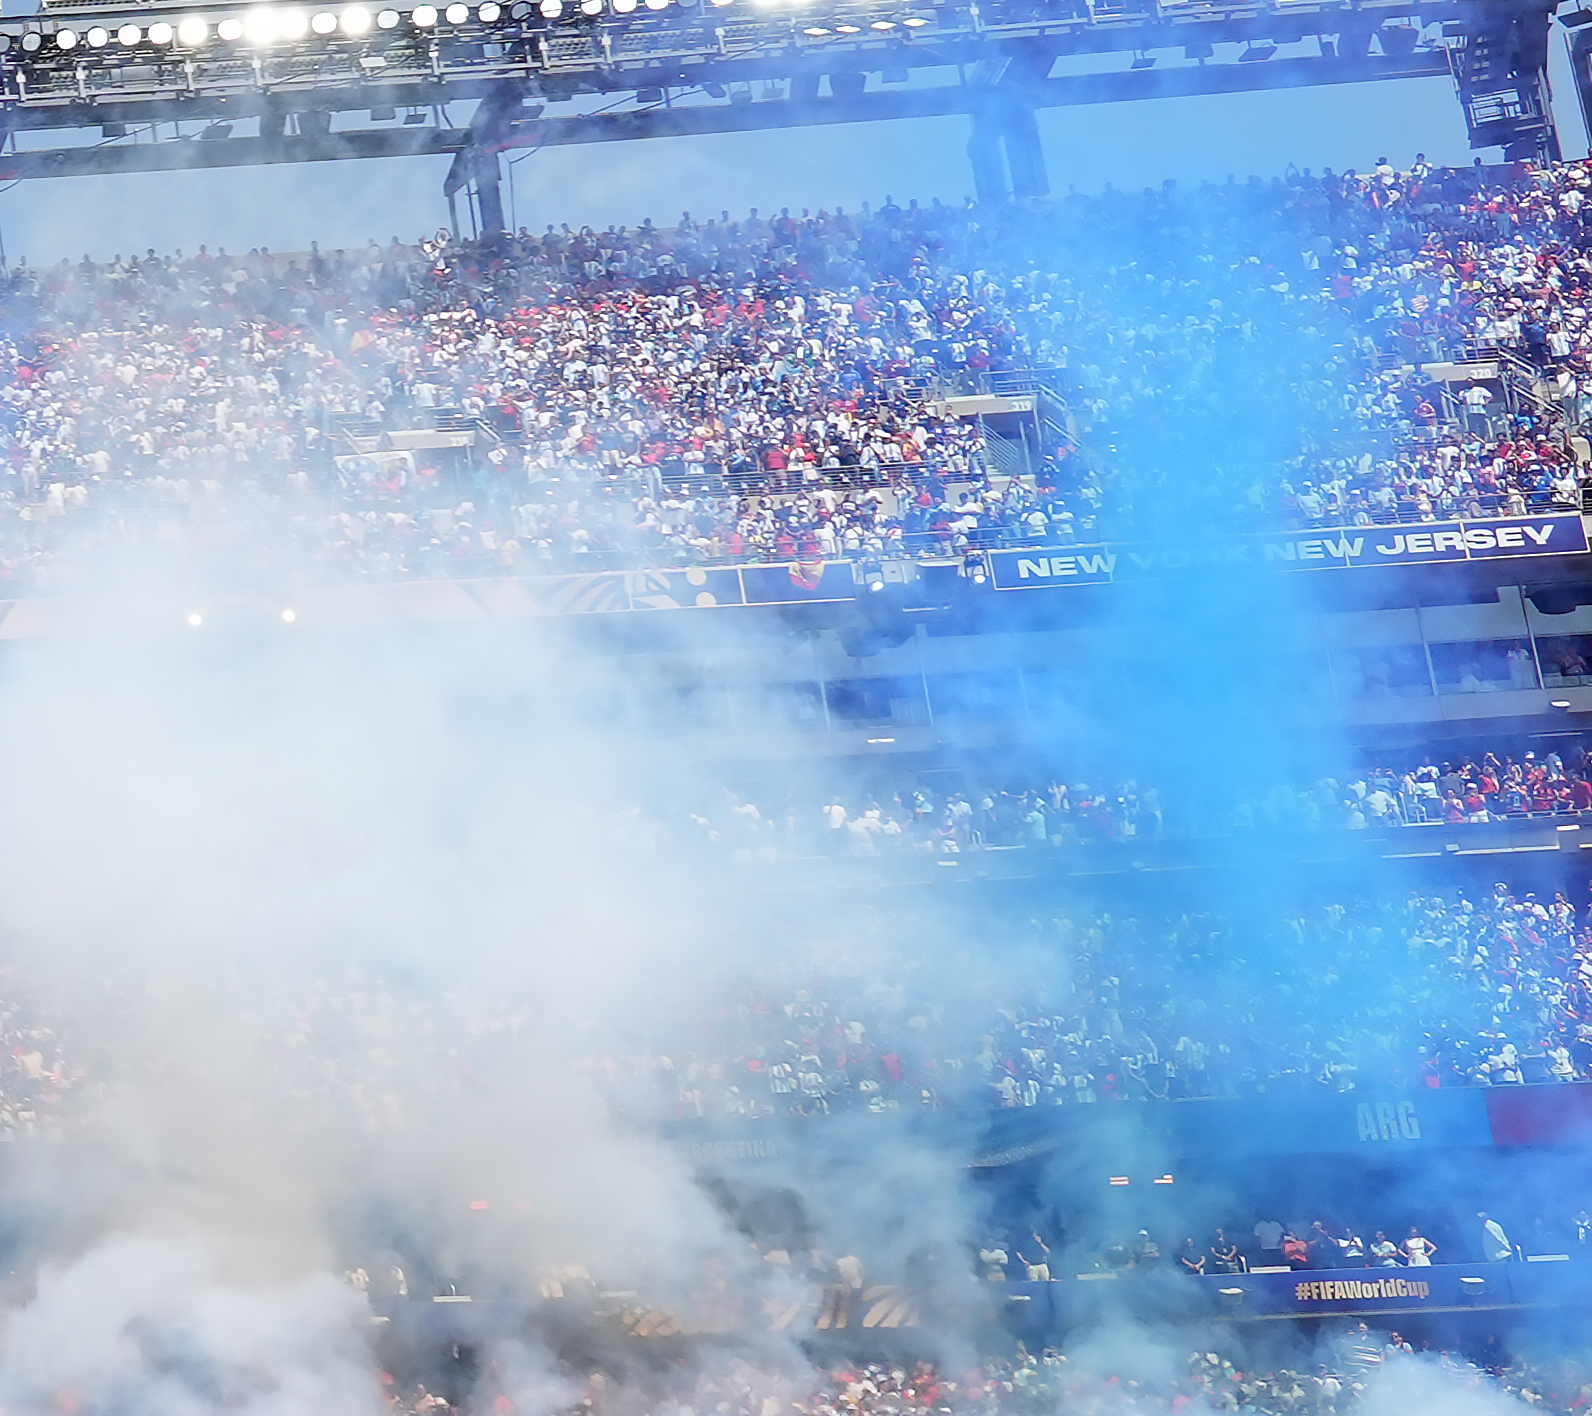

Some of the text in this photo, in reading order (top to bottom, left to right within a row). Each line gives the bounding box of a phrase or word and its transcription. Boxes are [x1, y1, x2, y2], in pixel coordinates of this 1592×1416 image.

[1018, 553, 1117, 579] NEW
[1264, 536, 1365, 562] NEW
[1376, 524, 1556, 556] JERSEY
[1357, 1100, 1422, 1142] ARG
[1295, 1277, 1430, 1301] #FIFAWorldCup
